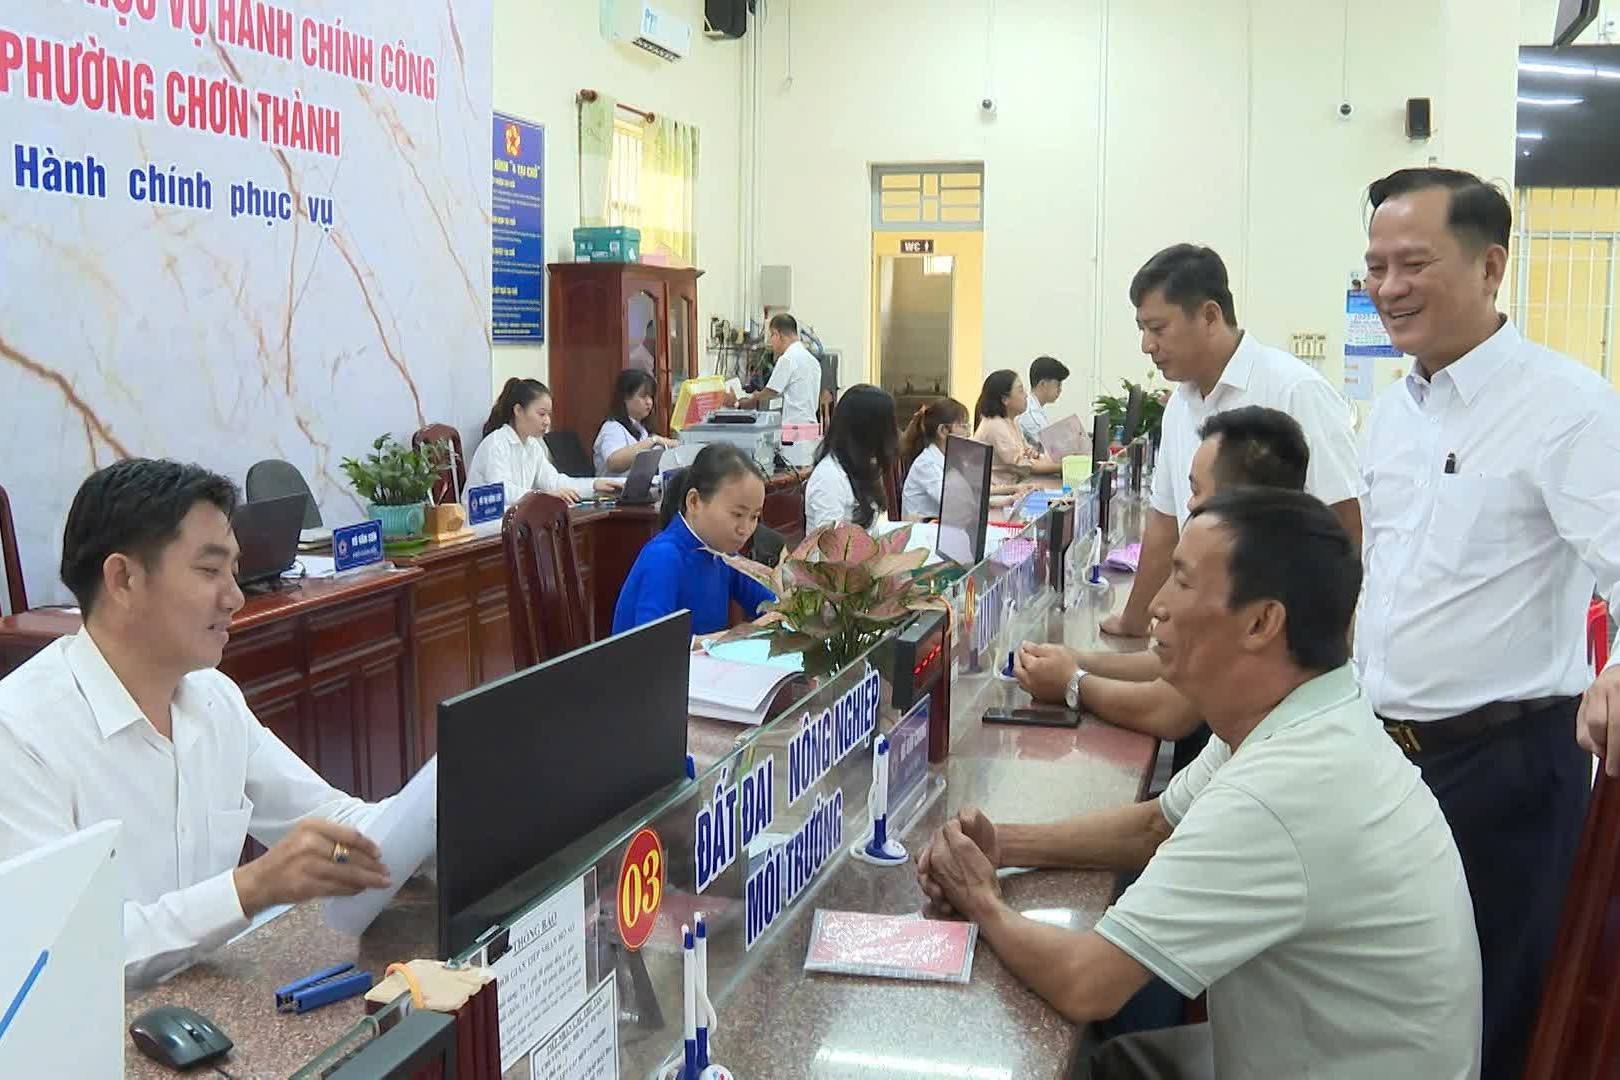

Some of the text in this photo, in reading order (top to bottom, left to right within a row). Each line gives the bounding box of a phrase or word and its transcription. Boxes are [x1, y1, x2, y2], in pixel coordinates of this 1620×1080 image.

[0, 31, 340, 156] PHƯỜNG CHƠN THÀNH
[302, 18, 373, 84] CHÍNH
[380, 39, 436, 100] CÔNG
[14, 145, 333, 232] Hành chính phục vụ
[904, 241, 921, 252] WC
[696, 768, 737, 890] ĐẤT
[742, 757, 772, 850] ĐAI
[789, 712, 831, 805] NÔNG
[834, 660, 879, 763] NGHIỆP
[622, 849, 660, 928] 03
[746, 790, 842, 949] MÔI TRƯỜNG
